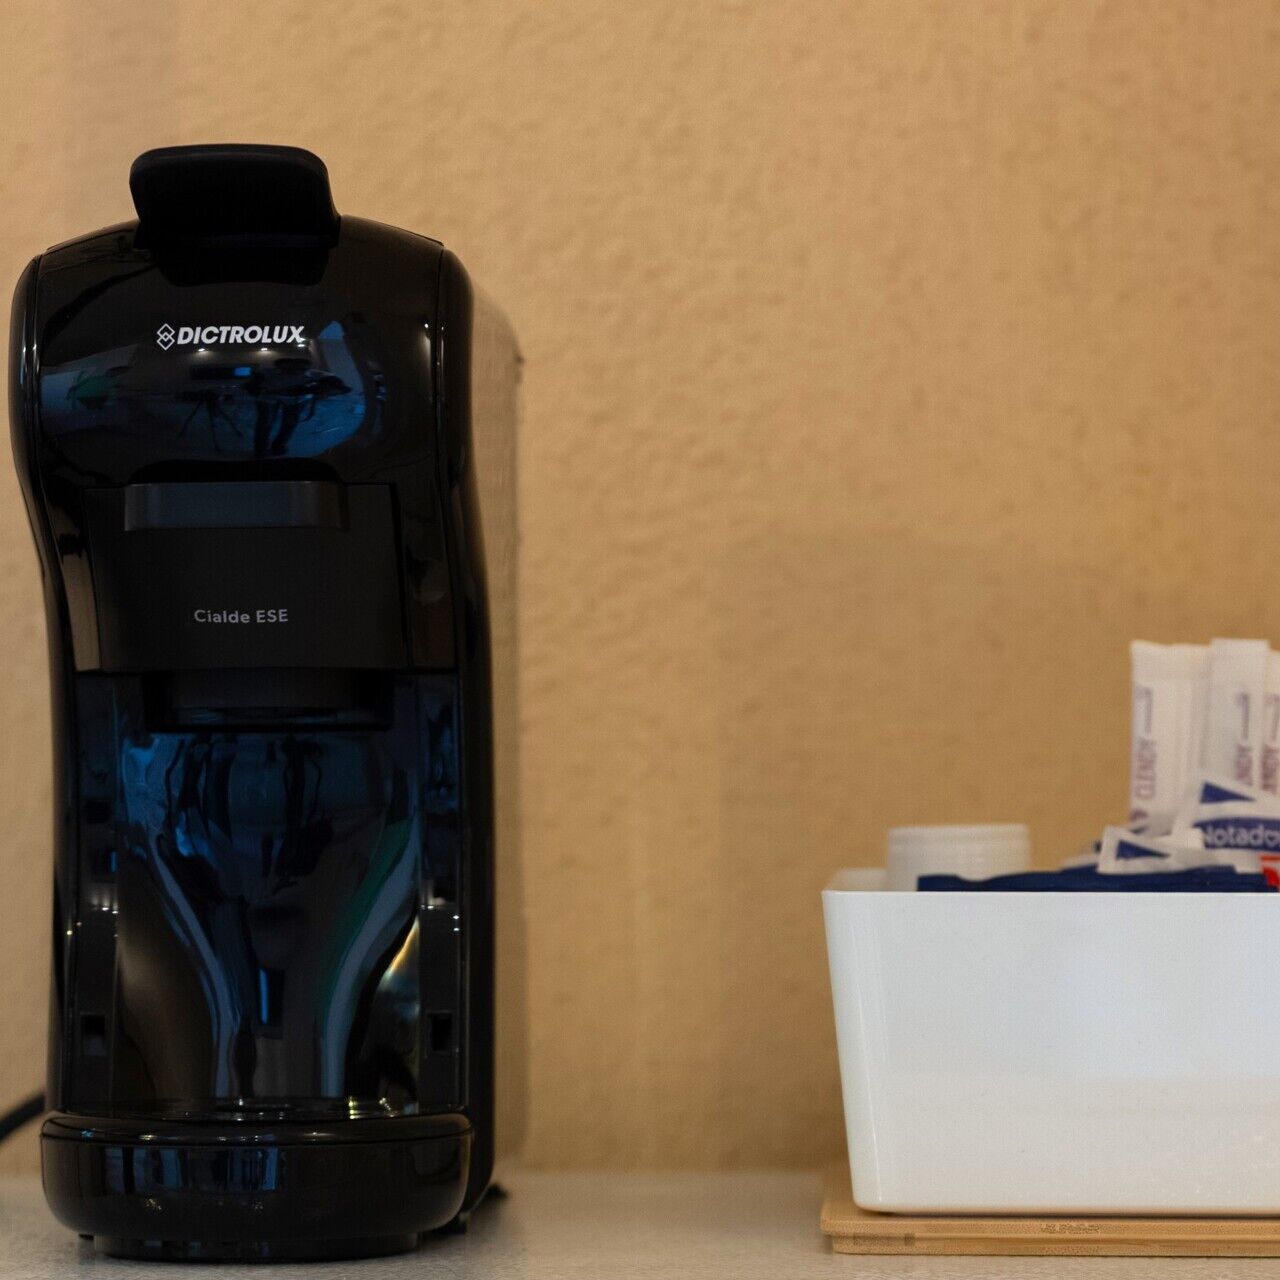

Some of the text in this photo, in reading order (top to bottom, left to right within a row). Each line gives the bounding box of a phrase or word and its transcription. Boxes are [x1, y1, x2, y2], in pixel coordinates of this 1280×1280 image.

[178, 325, 306, 345] DICTROLUX
[194, 609, 288, 624] Cialde ESE
